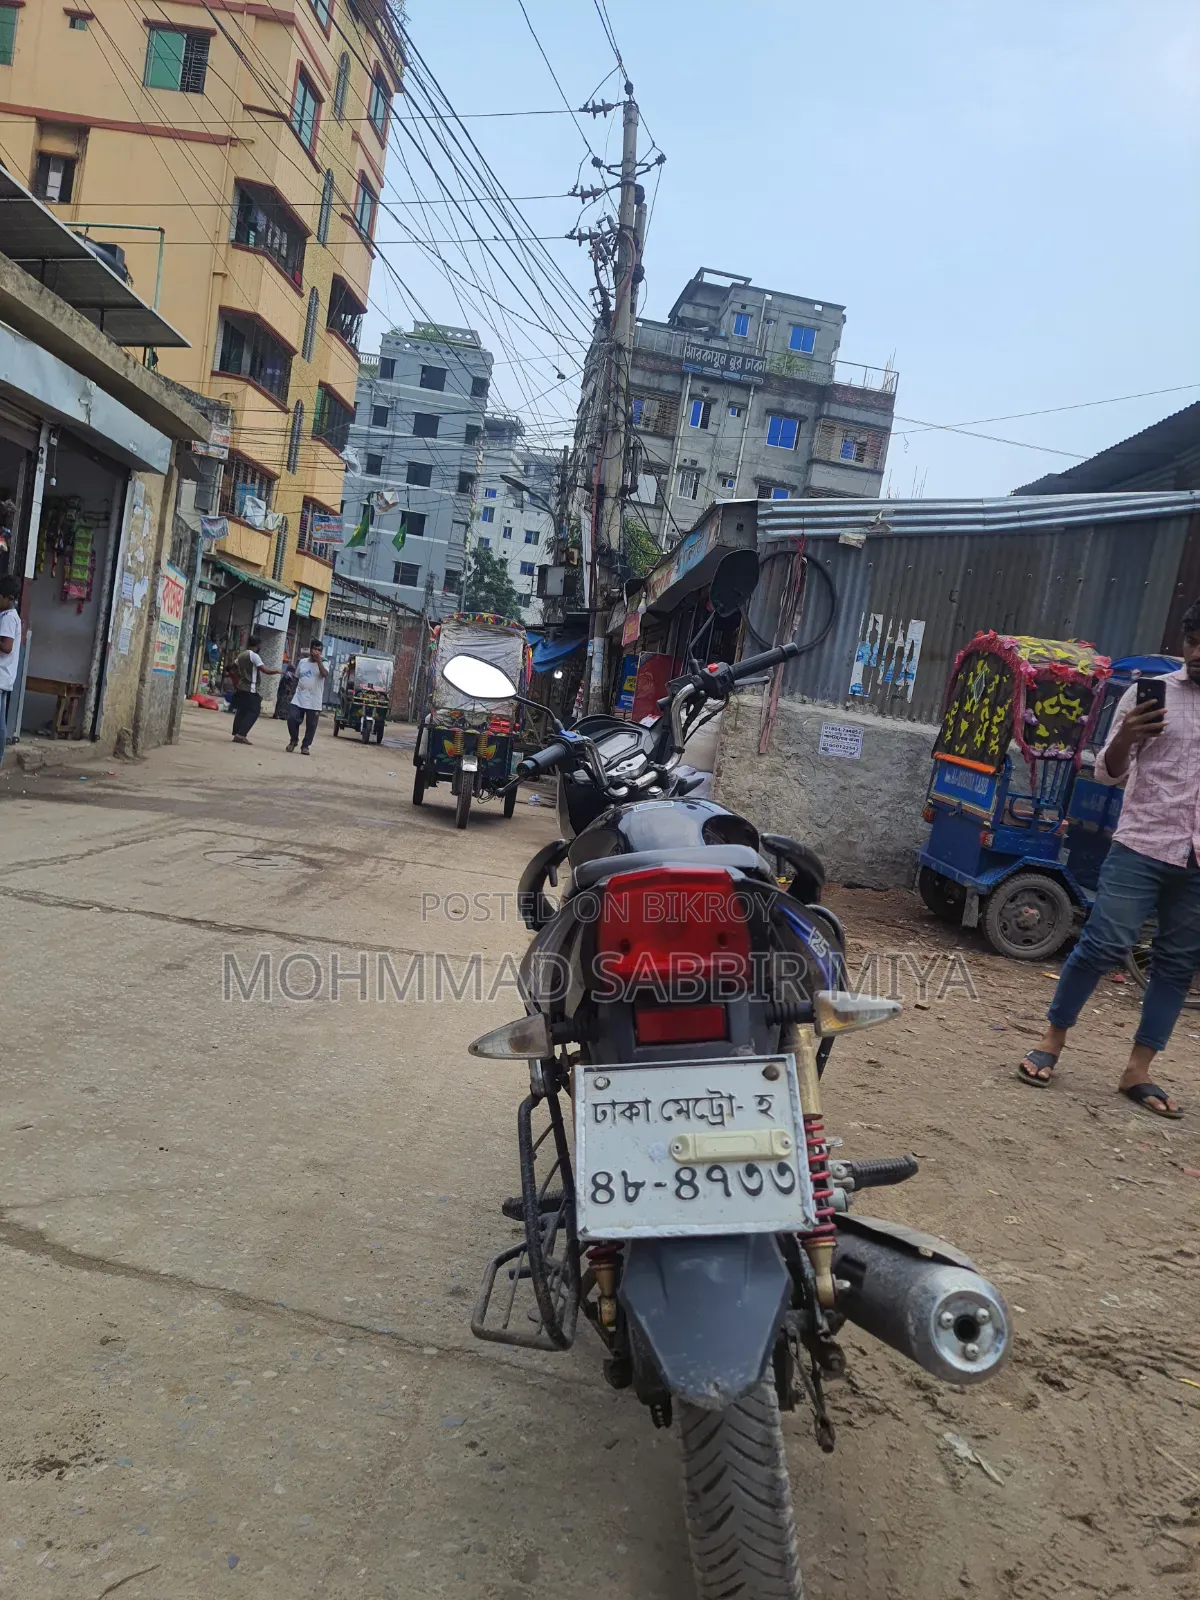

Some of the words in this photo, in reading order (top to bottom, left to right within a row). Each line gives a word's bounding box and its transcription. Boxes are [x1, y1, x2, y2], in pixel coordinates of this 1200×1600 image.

[745, 357, 767, 373] ঢাকা
[808, 926, 830, 959] 125
[592, 1097, 652, 1124] ঢাকা
[660, 1089, 744, 1126] মেট্রো-
[754, 1093, 775, 1120] হ
[590, 1161, 797, 1205] ৪৮-৪৭৩৩
